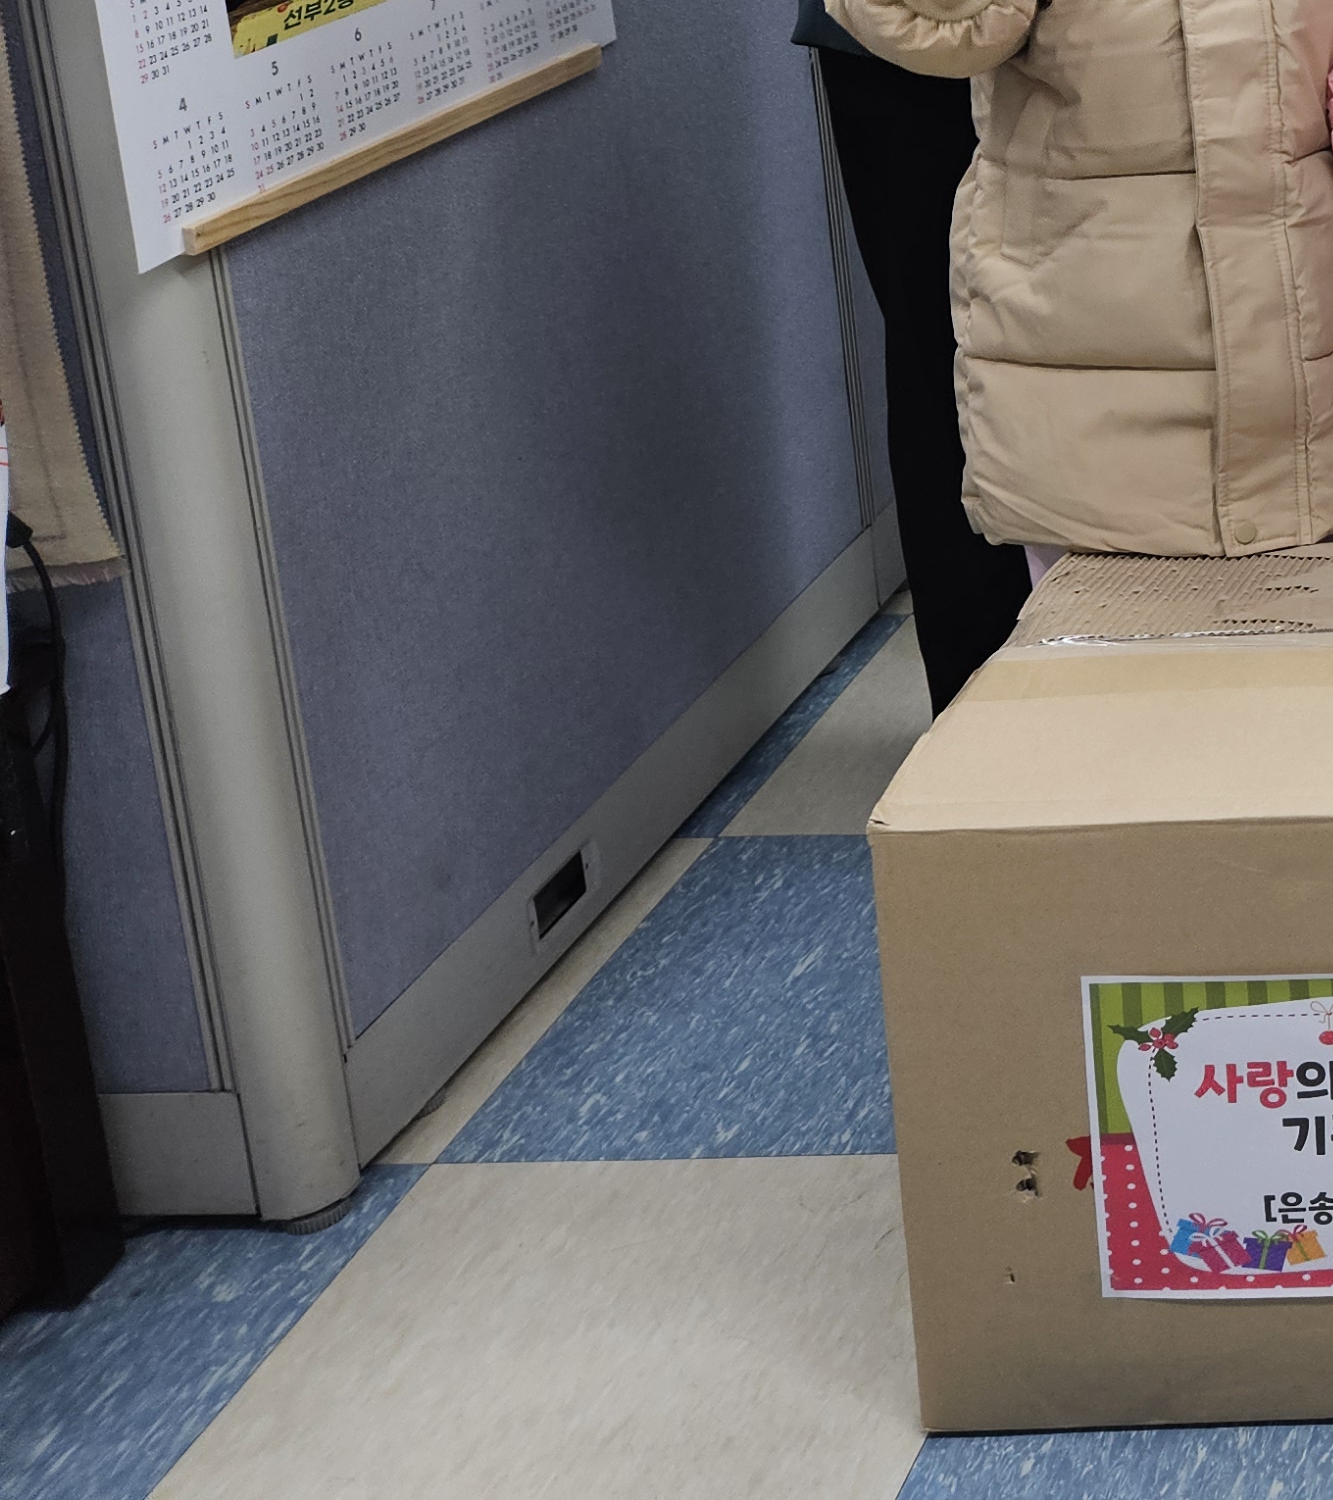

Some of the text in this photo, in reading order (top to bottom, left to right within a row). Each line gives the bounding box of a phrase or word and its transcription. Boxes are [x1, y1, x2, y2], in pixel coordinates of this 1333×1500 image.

[354, 27, 362, 42] 6
[271, 61, 279, 76] 5
[179, 97, 188, 111] 4
